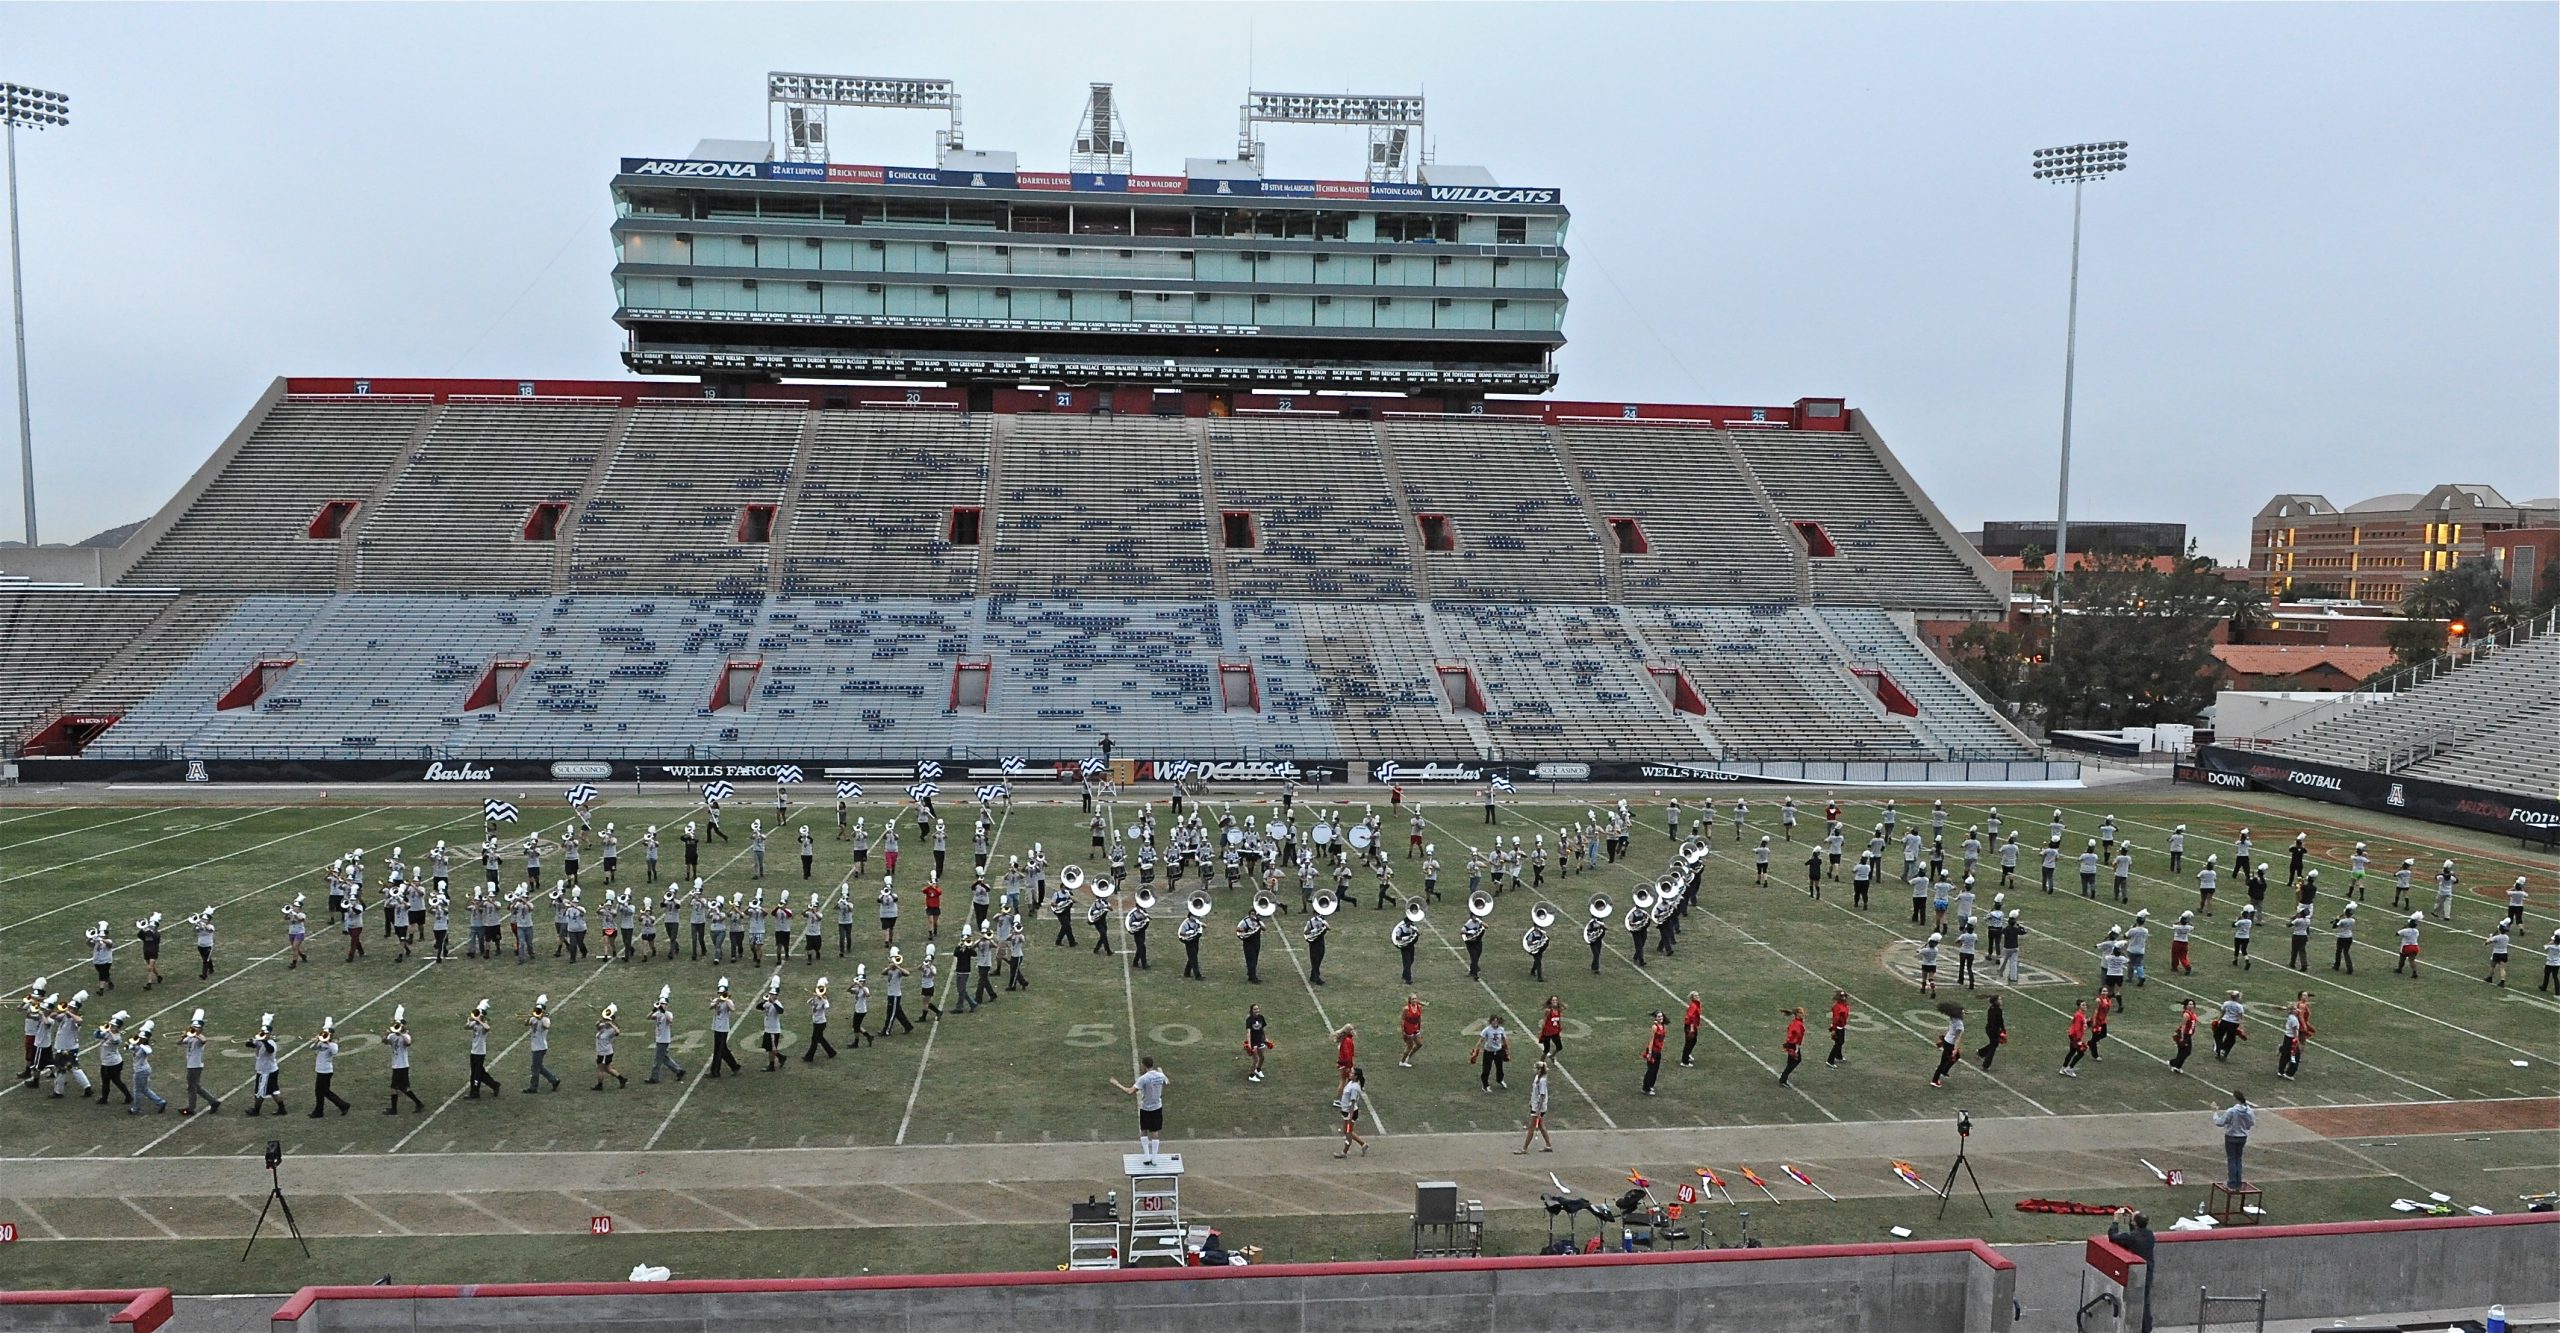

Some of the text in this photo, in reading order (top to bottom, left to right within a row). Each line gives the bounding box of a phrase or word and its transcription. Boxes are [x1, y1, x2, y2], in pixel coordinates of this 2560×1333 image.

[635, 161, 757, 177] ARIZONA
[772, 166, 823, 176] 22 ART LUPPINO
[837, 169, 857, 177] RICKY
[858, 170, 883, 178] HUNLEY
[894, 171, 917, 179] CHUCK
[919, 172, 937, 180] CECIL
[1017, 176, 1022, 184] 4
[1051, 177, 1071, 185] LEWIS
[1128, 179, 1136, 187] 92
[1151, 181, 1182, 189] WALDROP
[1316, 184, 1369, 193] 11 CHRIS McALISTER
[1371, 186, 1423, 196] 5 ANTOINE CASON
[1431, 187, 1553, 203] WILDCATS
[356, 385, 368, 395] 17
[520, 386, 532, 396] 18
[704, 389, 715, 399] 19
[907, 393, 920, 402] 20
[1058, 396, 1069, 405] 21
[1279, 401, 1291, 410] 22
[1471, 405, 1483, 414] 23
[1624, 409, 1635, 418] 24
[1752, 413, 1764, 422] 25
[186, 760, 208, 781] A
[423, 761, 494, 780] Bashas'
[669, 765, 777, 776] WELLS FARGO
[1641, 766, 1690, 778] WELLS
[2208, 772, 2245, 788] DOWN
[2288, 770, 2342, 791] FOOTBALL
[2456, 799, 2511, 818] ARIZONA
[2170, 1171, 2182, 1184] 30
[1679, 1185, 1693, 1202] 40
[1145, 1196, 1161, 1210] 50
[593, 1218, 609, 1233] 40
